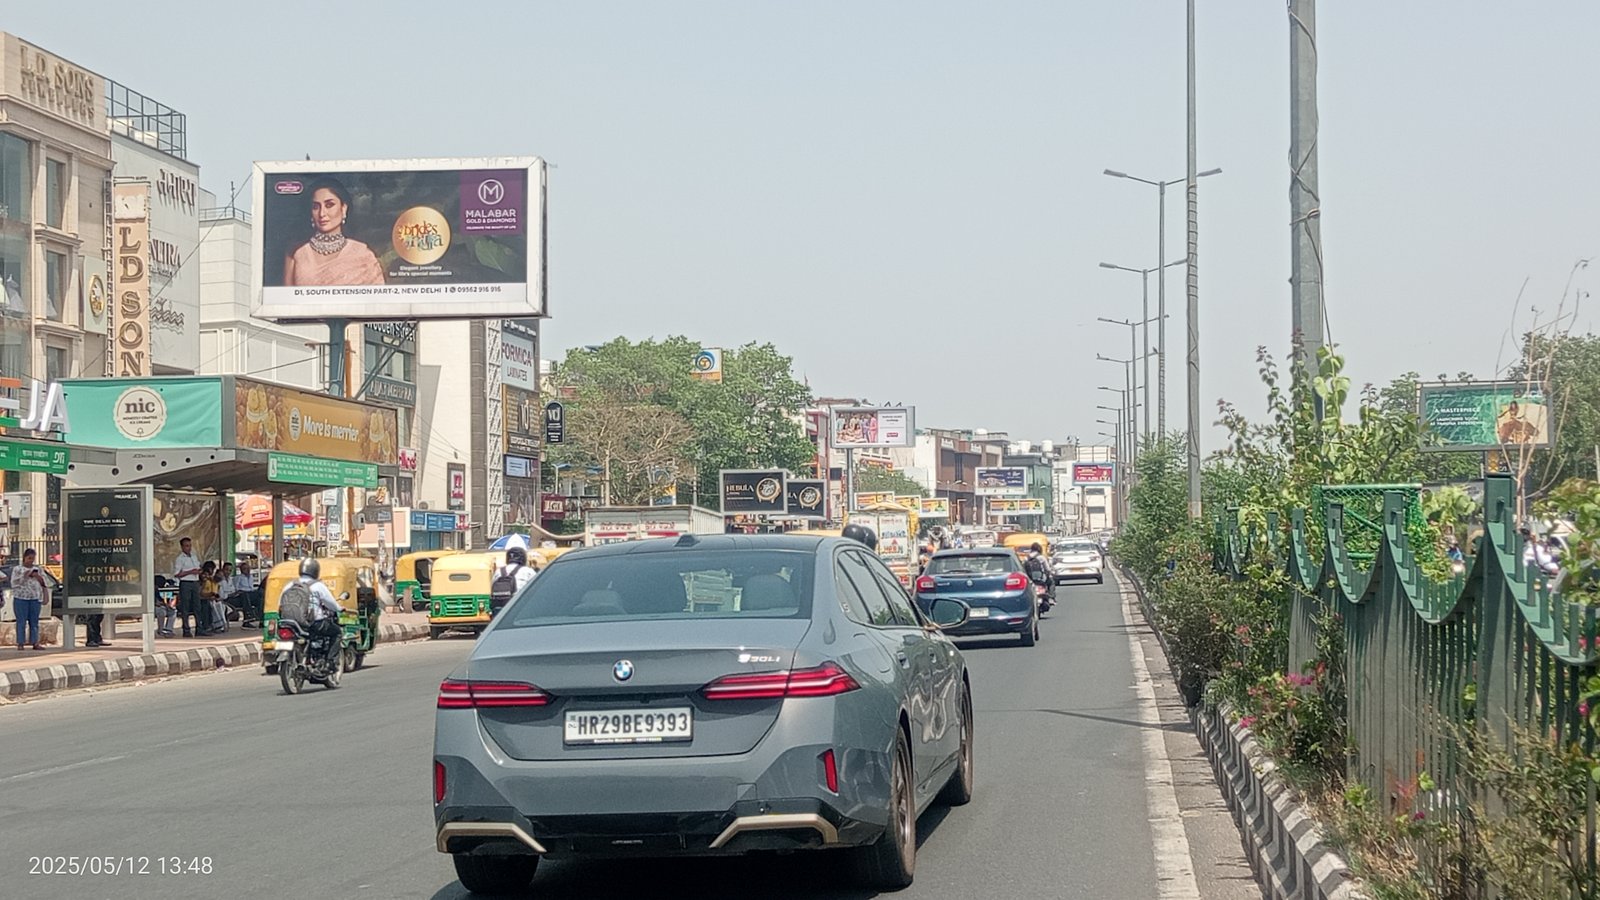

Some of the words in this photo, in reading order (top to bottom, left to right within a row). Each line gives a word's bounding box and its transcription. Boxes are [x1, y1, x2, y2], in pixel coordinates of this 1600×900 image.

[55, 61, 94, 101] SONS
[465, 209, 517, 218] MALABAR
[373, 287, 401, 295] PART-2,
[420, 286, 442, 294] DELHI
[501, 342, 532, 367] FORMICA
[124, 397, 156, 414] nic
[303, 415, 324, 437] More
[324, 419, 331, 438] is
[332, 423, 361, 443] merrier.
[78, 538, 133, 547] LUXURIOUS
[85, 566, 127, 574] CENTRAL
[105, 574, 133, 582] DELHI
[578, 712, 688, 735] HR29BE9393
